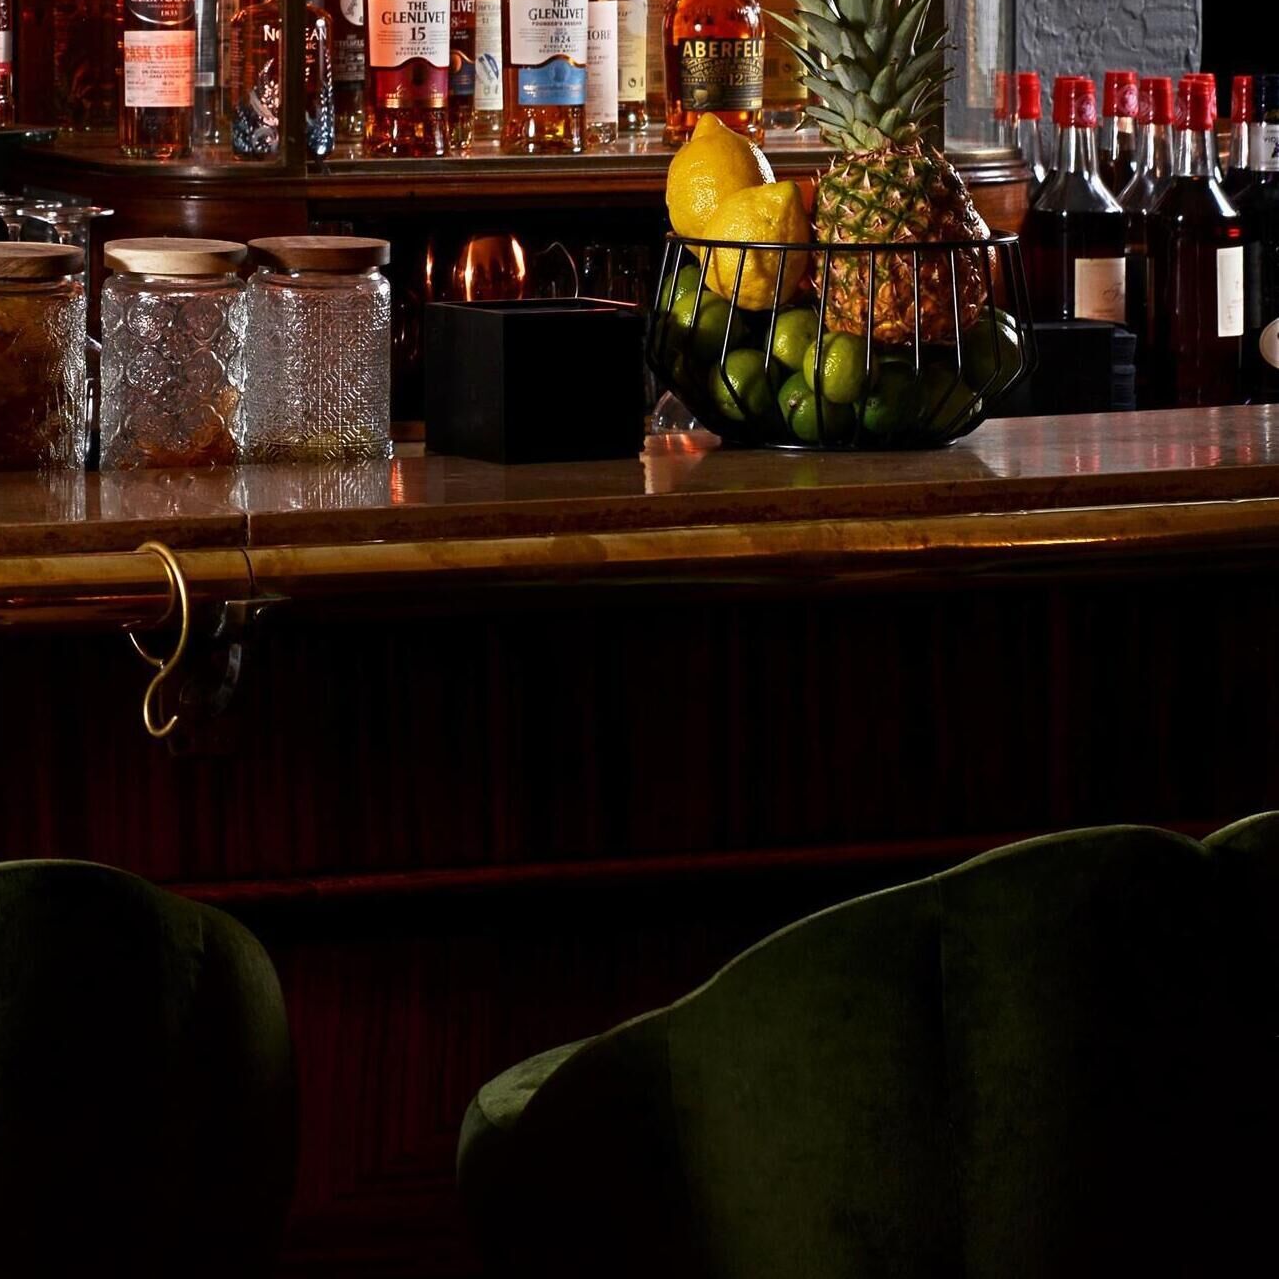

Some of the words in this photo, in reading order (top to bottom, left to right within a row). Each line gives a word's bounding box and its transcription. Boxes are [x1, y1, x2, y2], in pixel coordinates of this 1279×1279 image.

[406, 0, 428, 11] THE
[451, 0, 476, 14] LIVET
[381, 10, 446, 25] GLENLIVET
[528, 7, 585, 21] GLENLIVET
[409, 26, 427, 41] 15
[549, 35, 572, 44] 1824
[682, 40, 764, 58] ABERFELD
